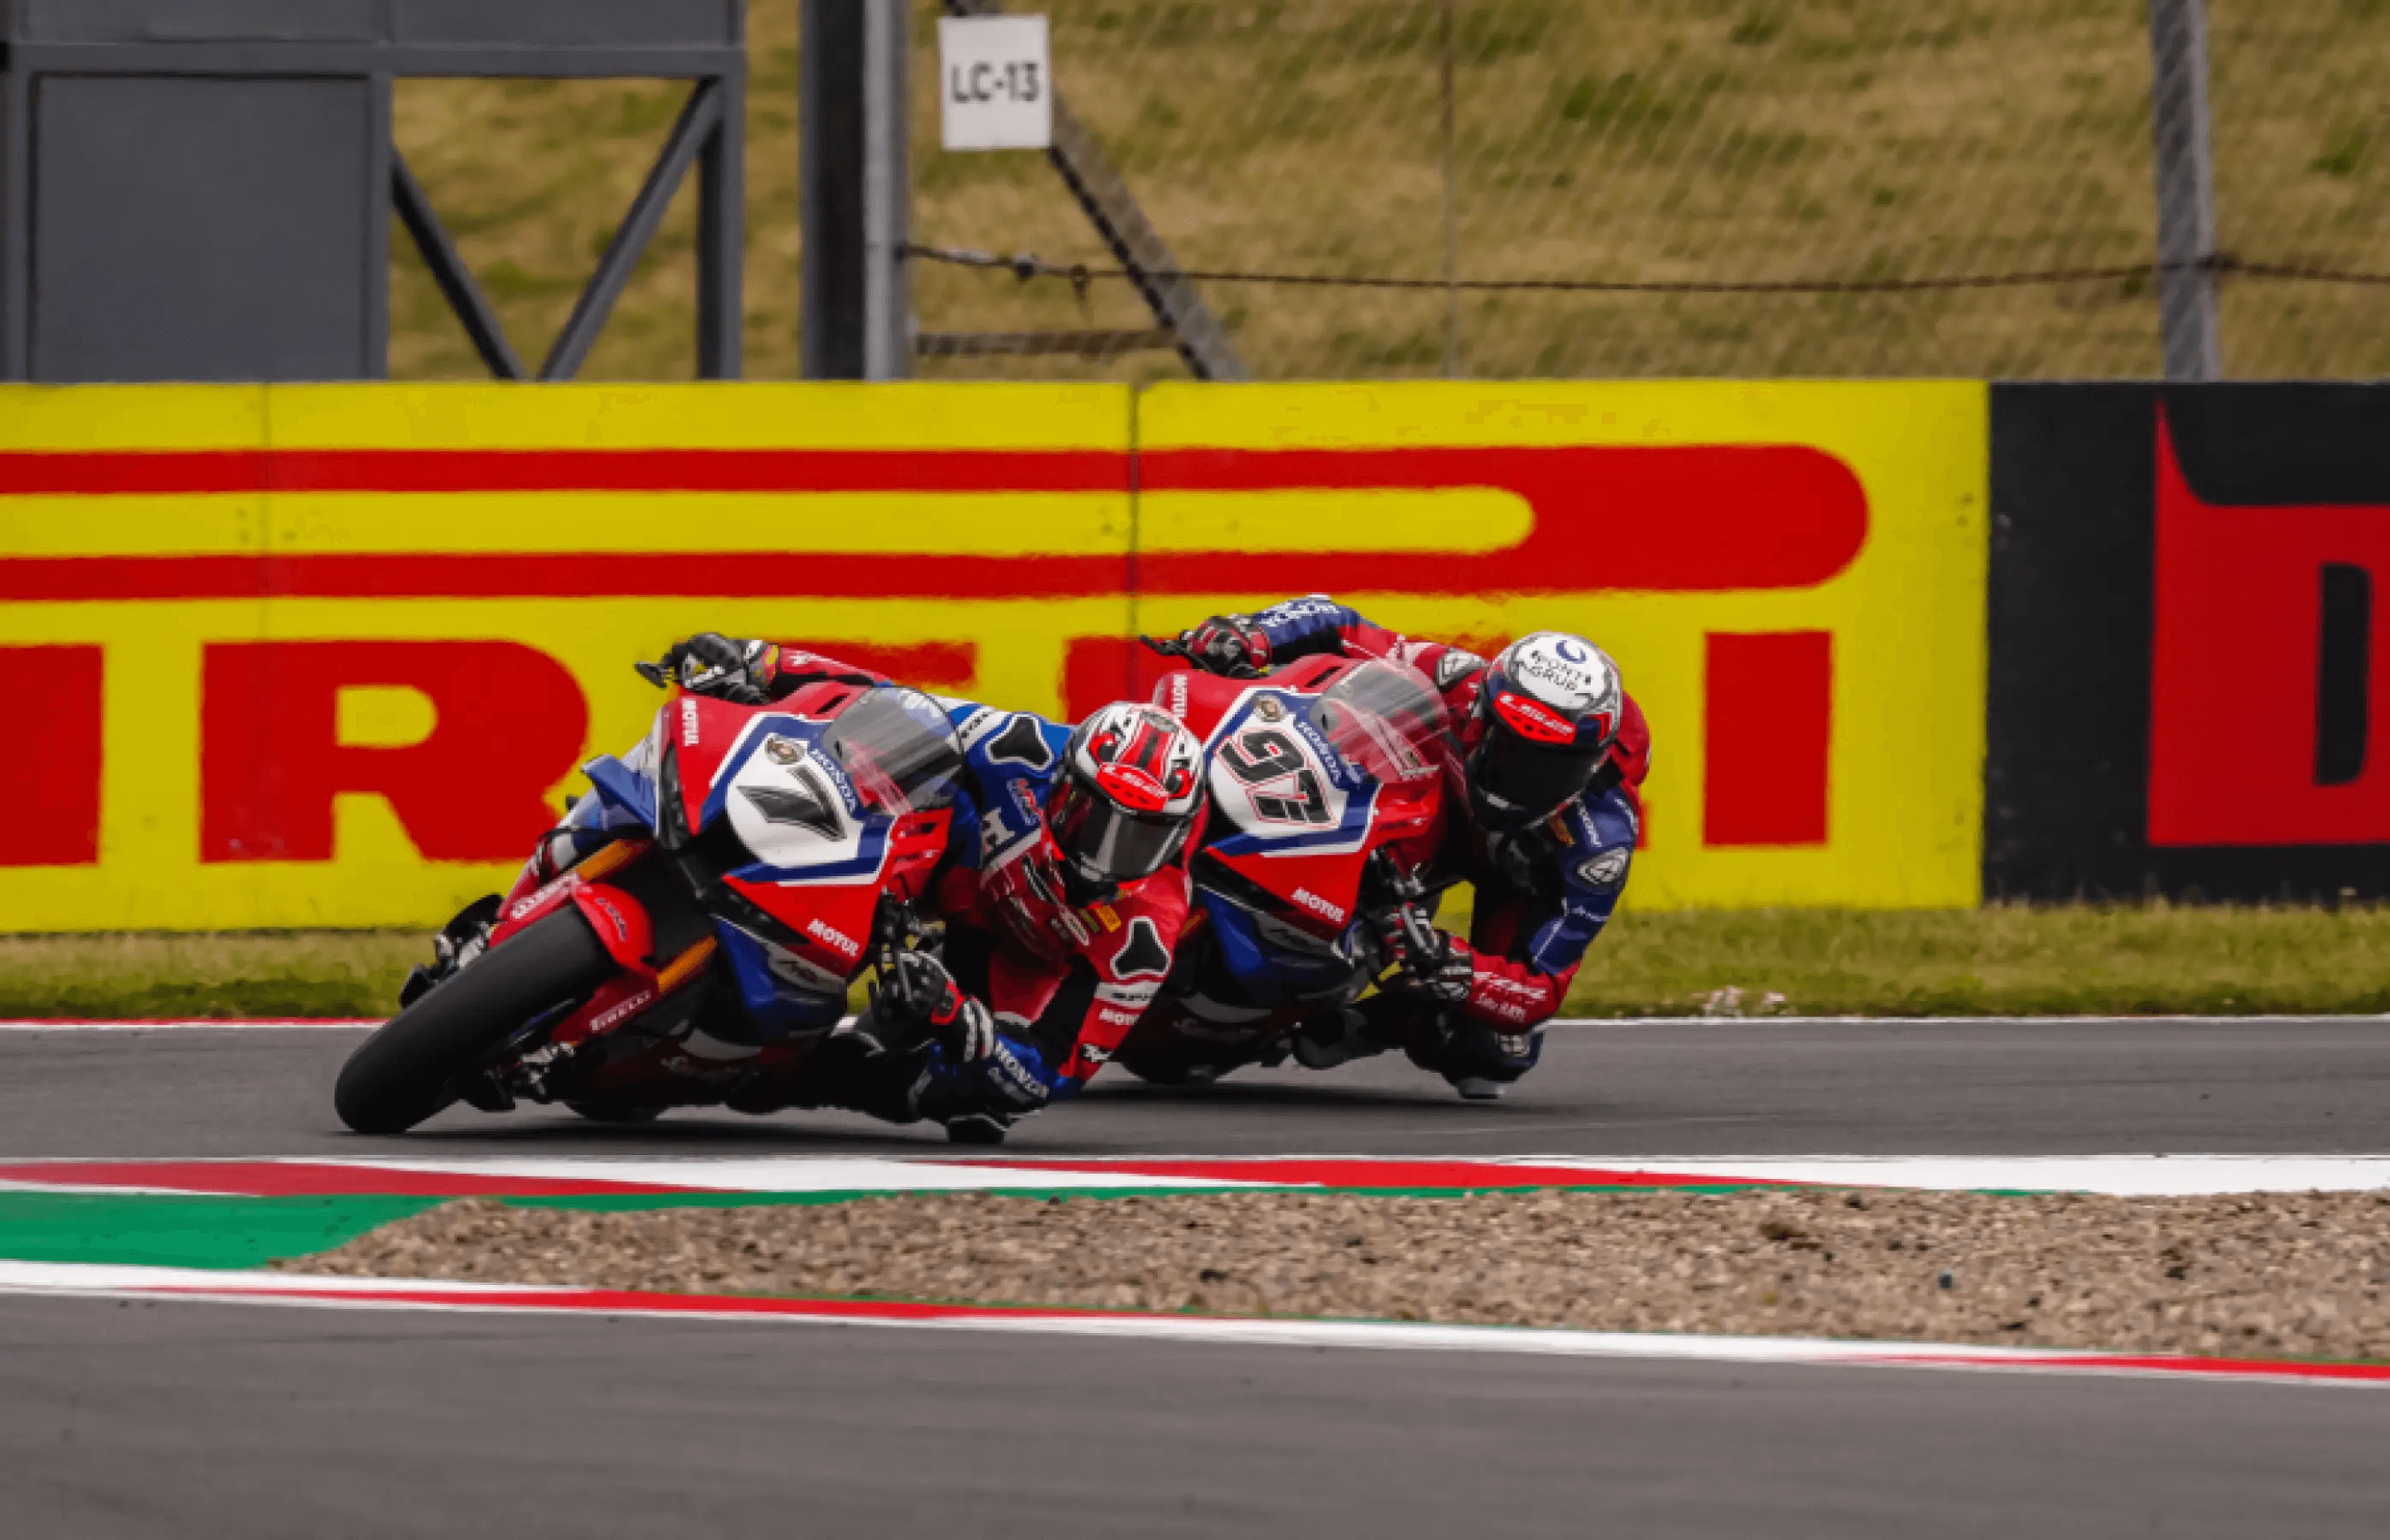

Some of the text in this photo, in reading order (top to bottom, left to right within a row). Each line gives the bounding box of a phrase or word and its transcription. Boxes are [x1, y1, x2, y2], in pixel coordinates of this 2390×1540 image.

[952, 61, 1039, 103] LC-13
[681, 697, 699, 747] MOTUL
[1213, 727, 1335, 834] 97
[1293, 721, 1343, 784] HONDA
[734, 764, 848, 844] 7
[808, 749, 856, 815] HONDA
[1290, 886, 1345, 922] MOTUL
[807, 918, 859, 957] MOTUL
